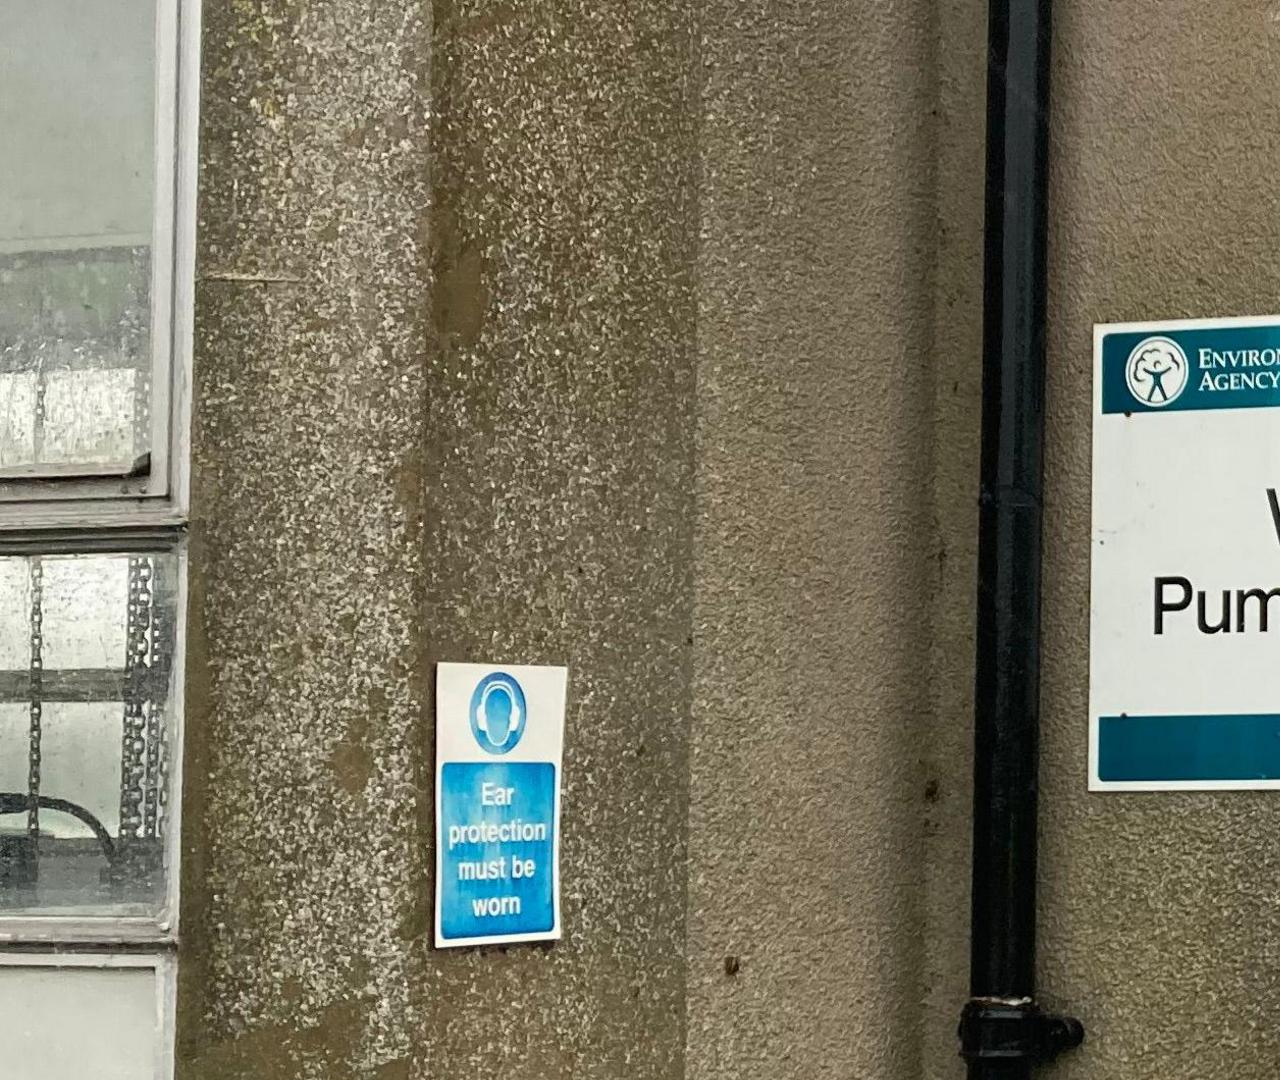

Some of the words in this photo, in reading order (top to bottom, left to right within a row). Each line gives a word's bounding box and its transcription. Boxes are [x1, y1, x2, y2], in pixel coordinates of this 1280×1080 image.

[1198, 371, 1280, 391] AGENCY
[481, 782, 515, 806] Ear
[449, 819, 547, 849] protection
[458, 858, 506, 880] must
[512, 855, 536, 878] be
[472, 896, 521, 917] worn
